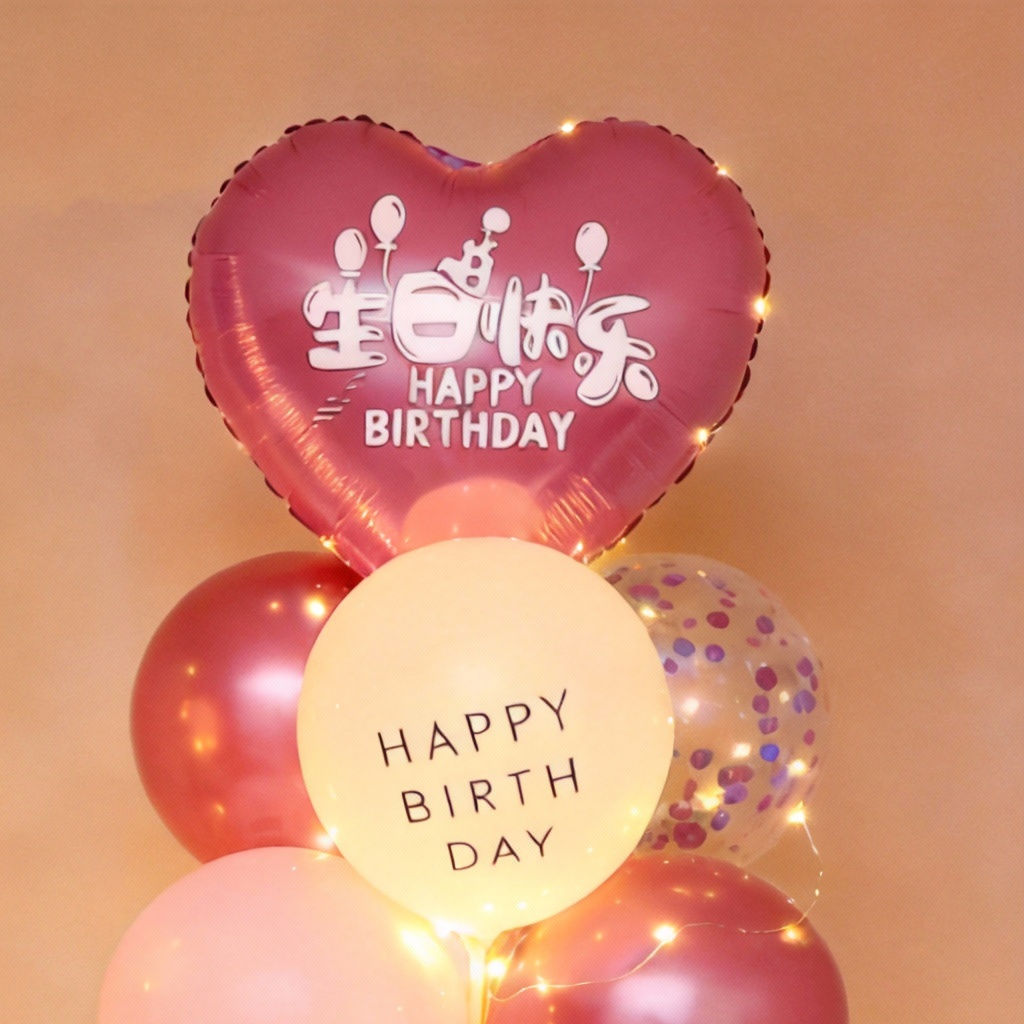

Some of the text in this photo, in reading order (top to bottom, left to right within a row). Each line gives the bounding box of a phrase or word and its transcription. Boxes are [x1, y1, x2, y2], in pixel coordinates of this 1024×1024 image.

[302, 271, 659, 407] 生日快乐
[408, 366, 543, 408] HAPPY
[364, 409, 576, 451] BIRTHDAY
[377, 688, 567, 767] HAPPY
[401, 757, 579, 824] BIRTH
[447, 826, 554, 871] DAY
